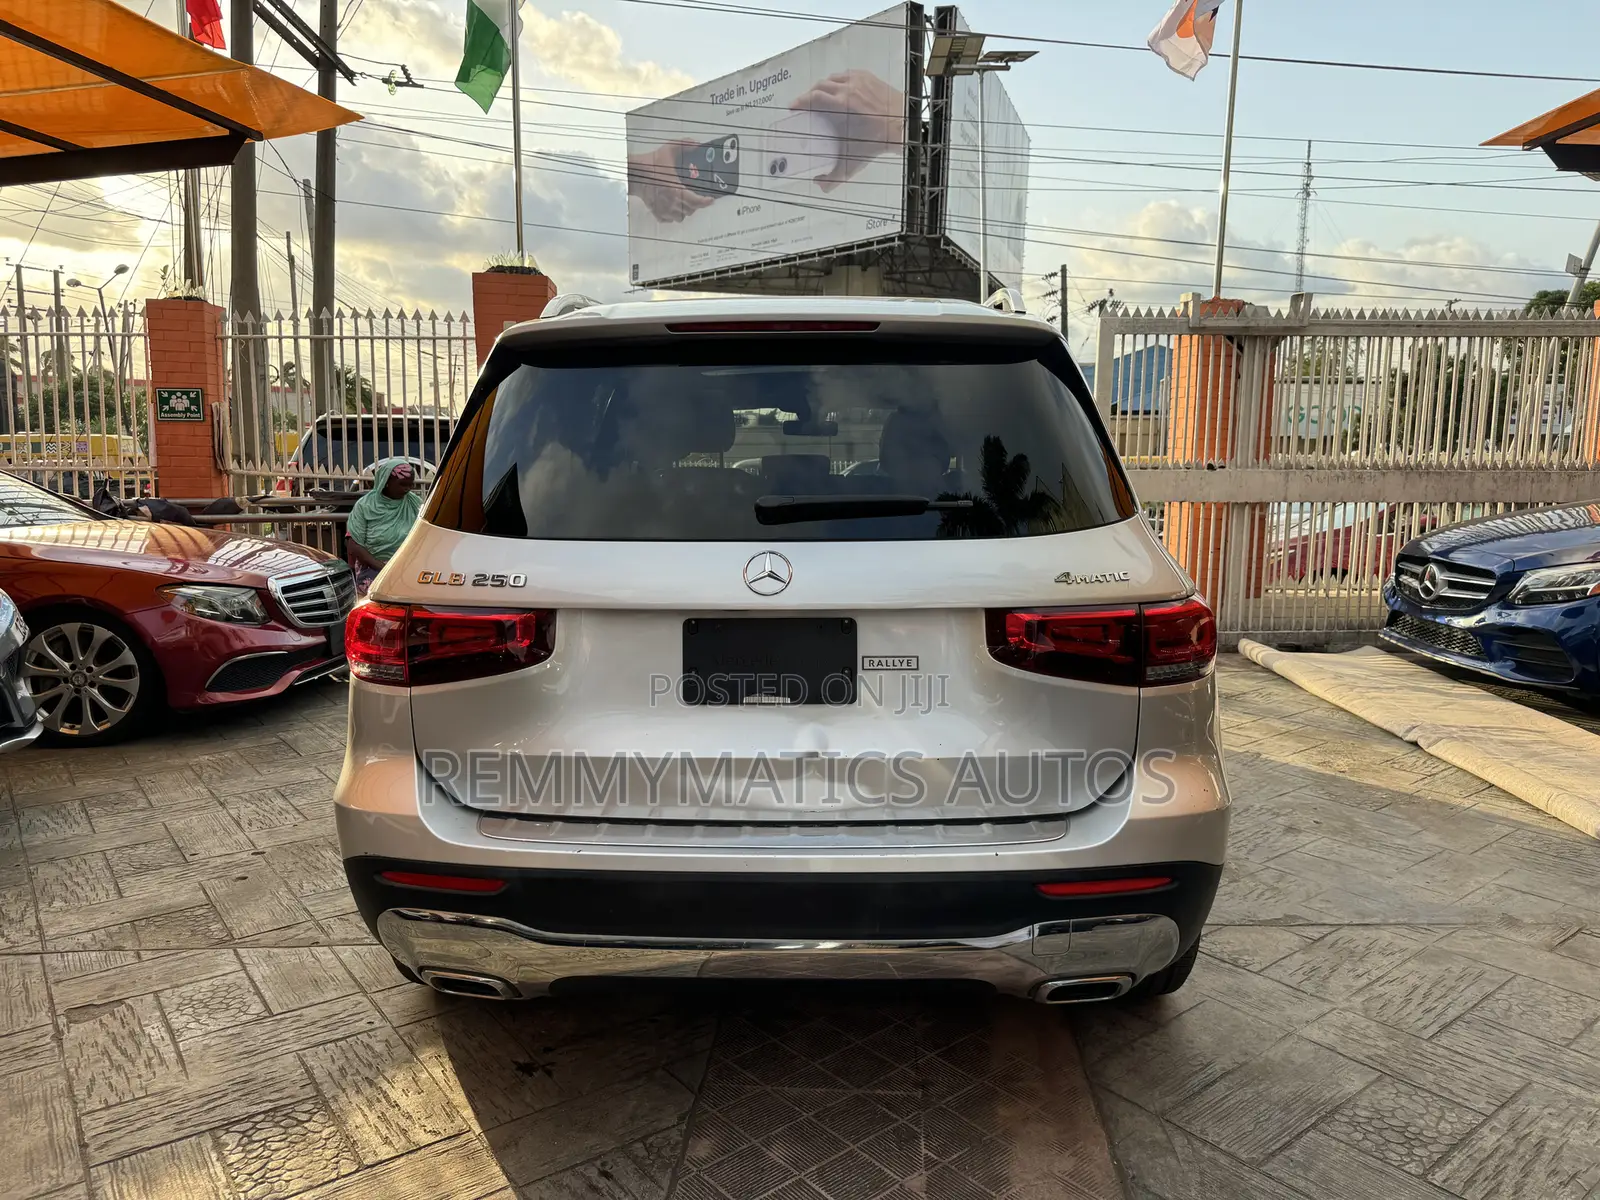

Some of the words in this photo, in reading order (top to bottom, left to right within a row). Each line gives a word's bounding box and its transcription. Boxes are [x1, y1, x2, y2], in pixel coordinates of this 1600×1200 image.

[710, 87, 735, 107] Trade
[736, 84, 748, 97] in.
[749, 68, 791, 93] Upgrade.
[741, 204, 761, 215] iPhone
[866, 218, 887, 230] iStore
[417, 570, 466, 587] GLB
[471, 572, 528, 588] 250
[1054, 571, 1131, 585] 4MATIC
[868, 658, 913, 668] RALLYE
